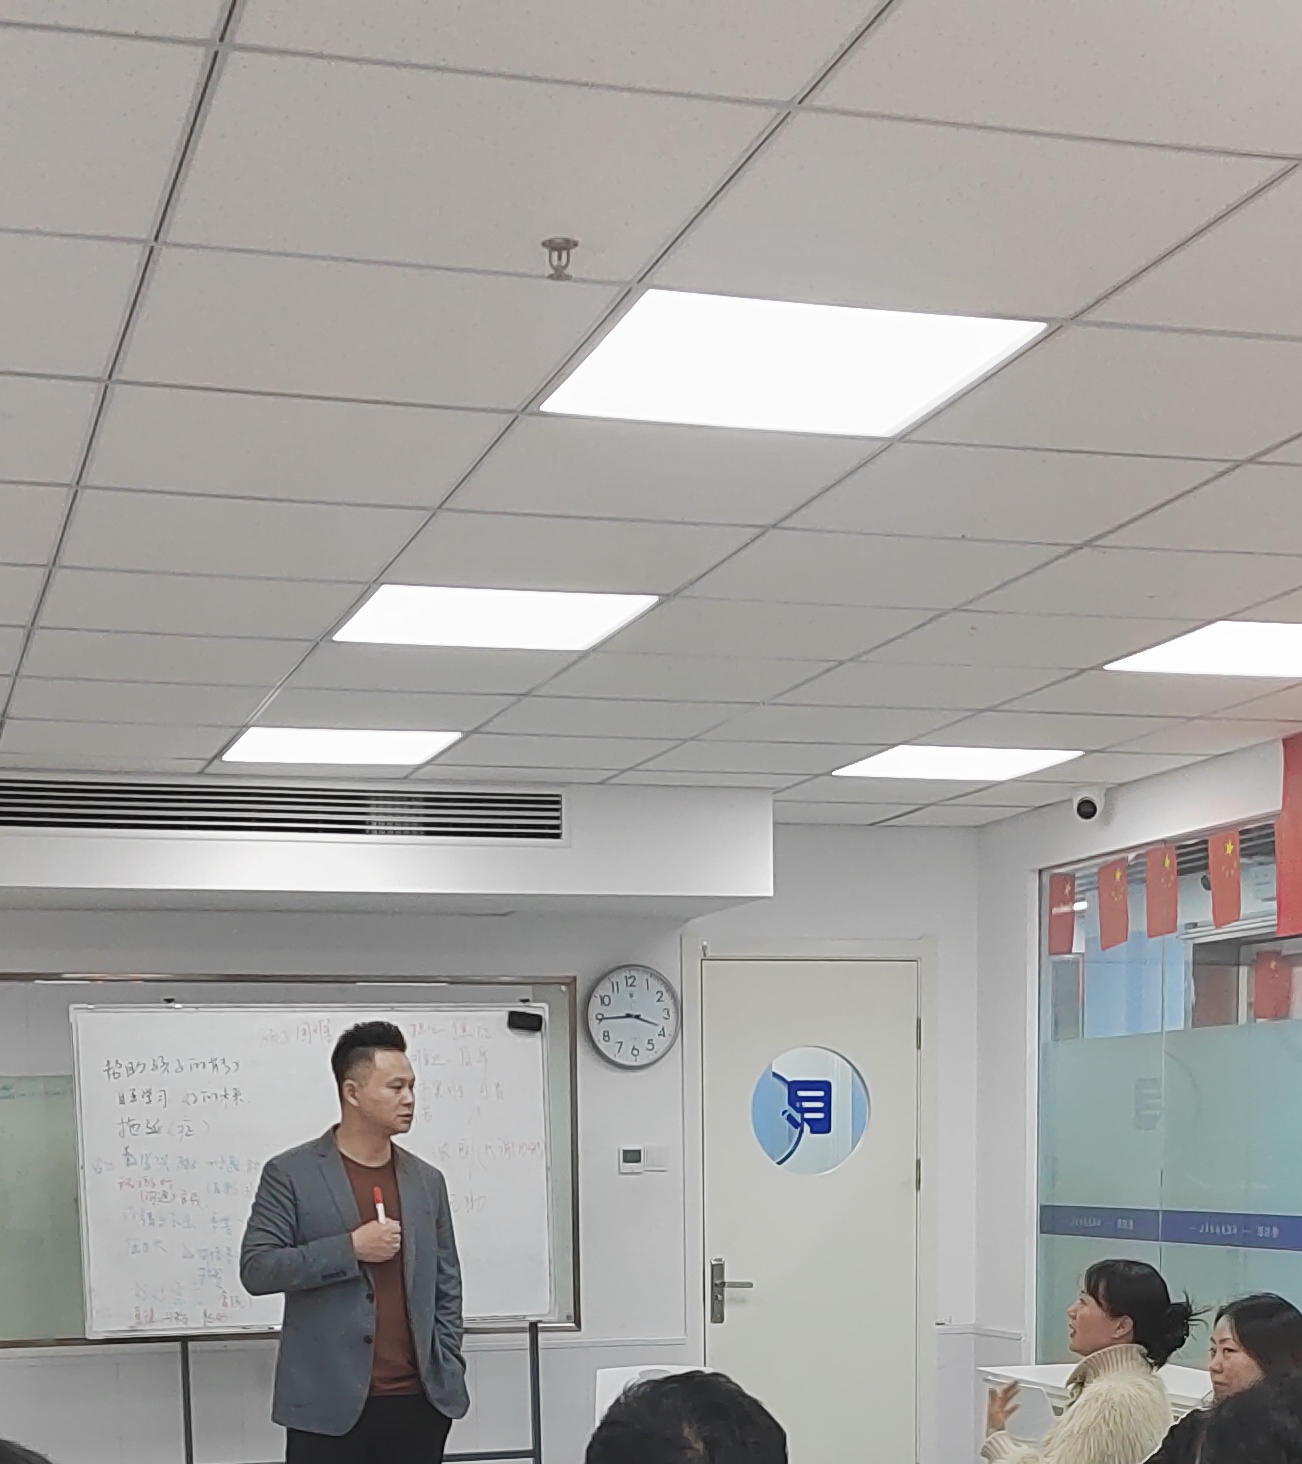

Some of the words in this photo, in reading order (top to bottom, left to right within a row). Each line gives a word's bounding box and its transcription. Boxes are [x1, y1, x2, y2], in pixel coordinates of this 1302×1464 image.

[611, 981, 620, 994] 11
[624, 975, 637, 988] 12
[599, 994, 611, 1007] 10
[655, 990, 665, 1003] 2
[595, 1012, 605, 1025] 9
[662, 1008, 671, 1020] 3
[602, 1030, 611, 1042] 8
[657, 1026, 666, 1038] 4
[614, 1041, 624, 1054] 7
[630, 1045, 640, 1057] 6
[646, 1039, 655, 1051] 5
